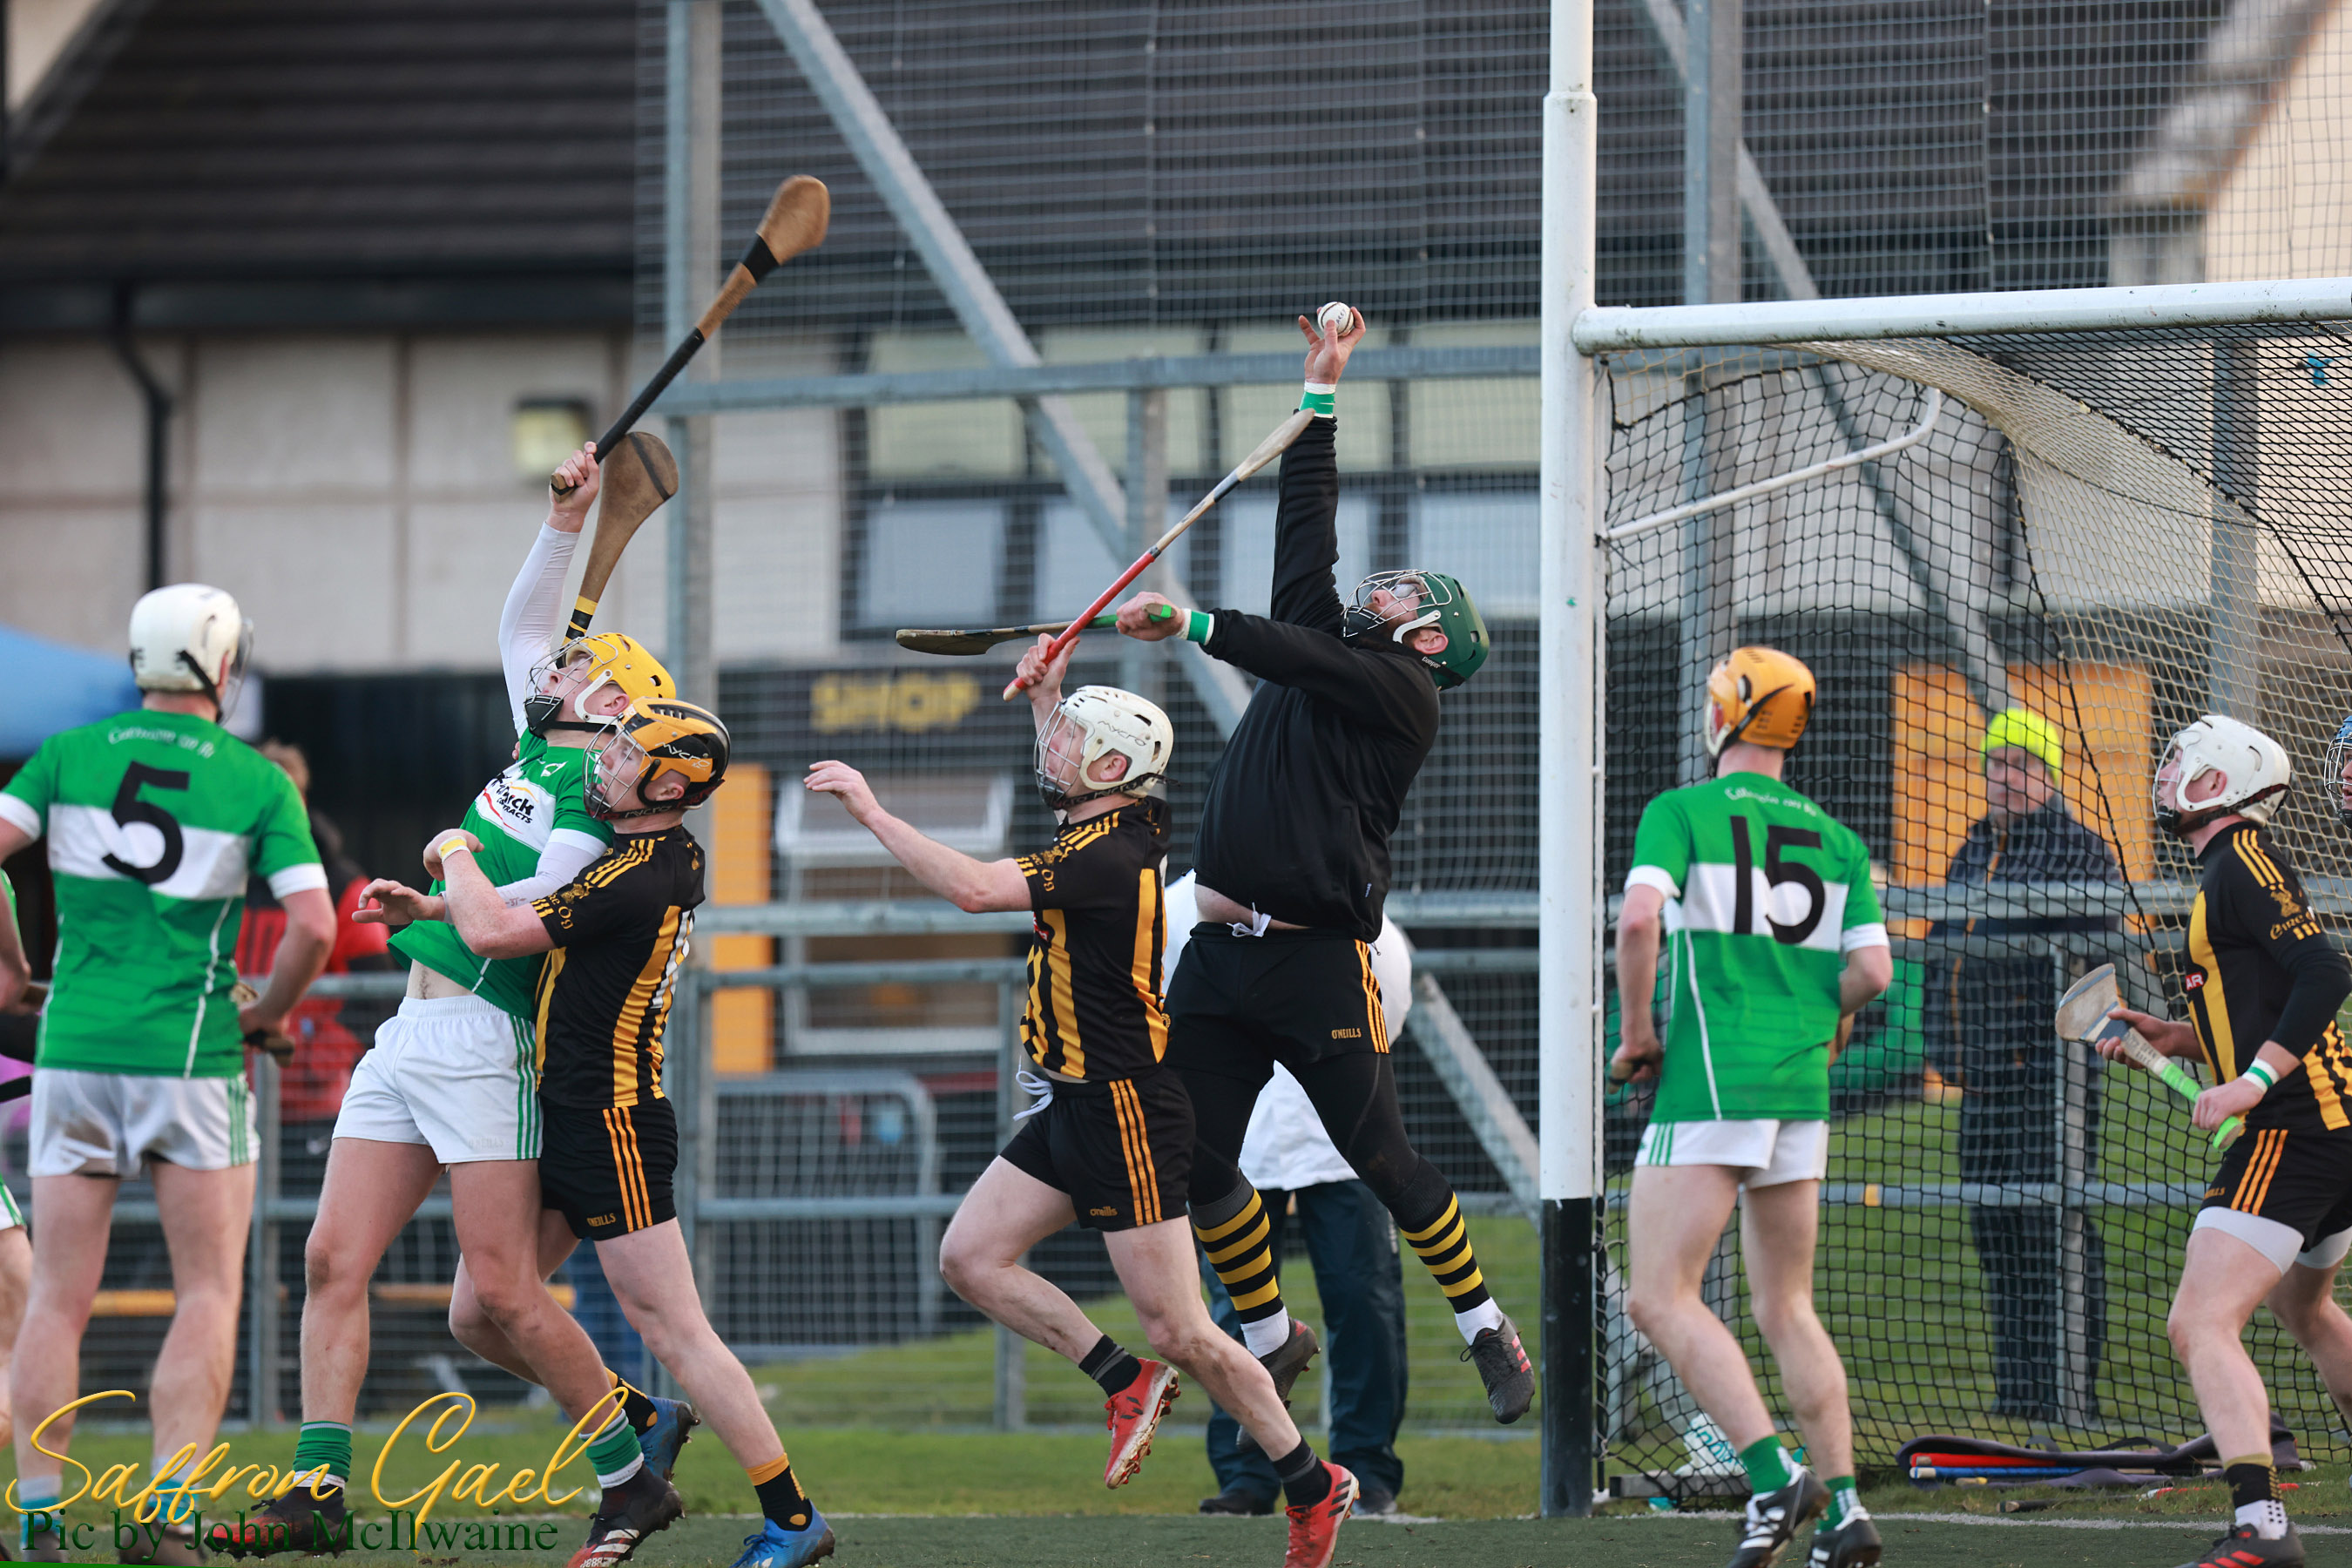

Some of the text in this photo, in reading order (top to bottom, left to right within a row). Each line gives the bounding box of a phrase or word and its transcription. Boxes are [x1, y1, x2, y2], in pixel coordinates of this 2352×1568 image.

[811, 673, 981, 733] SHOP
[102, 760, 190, 885] 5
[1730, 815, 1826, 945] 15
